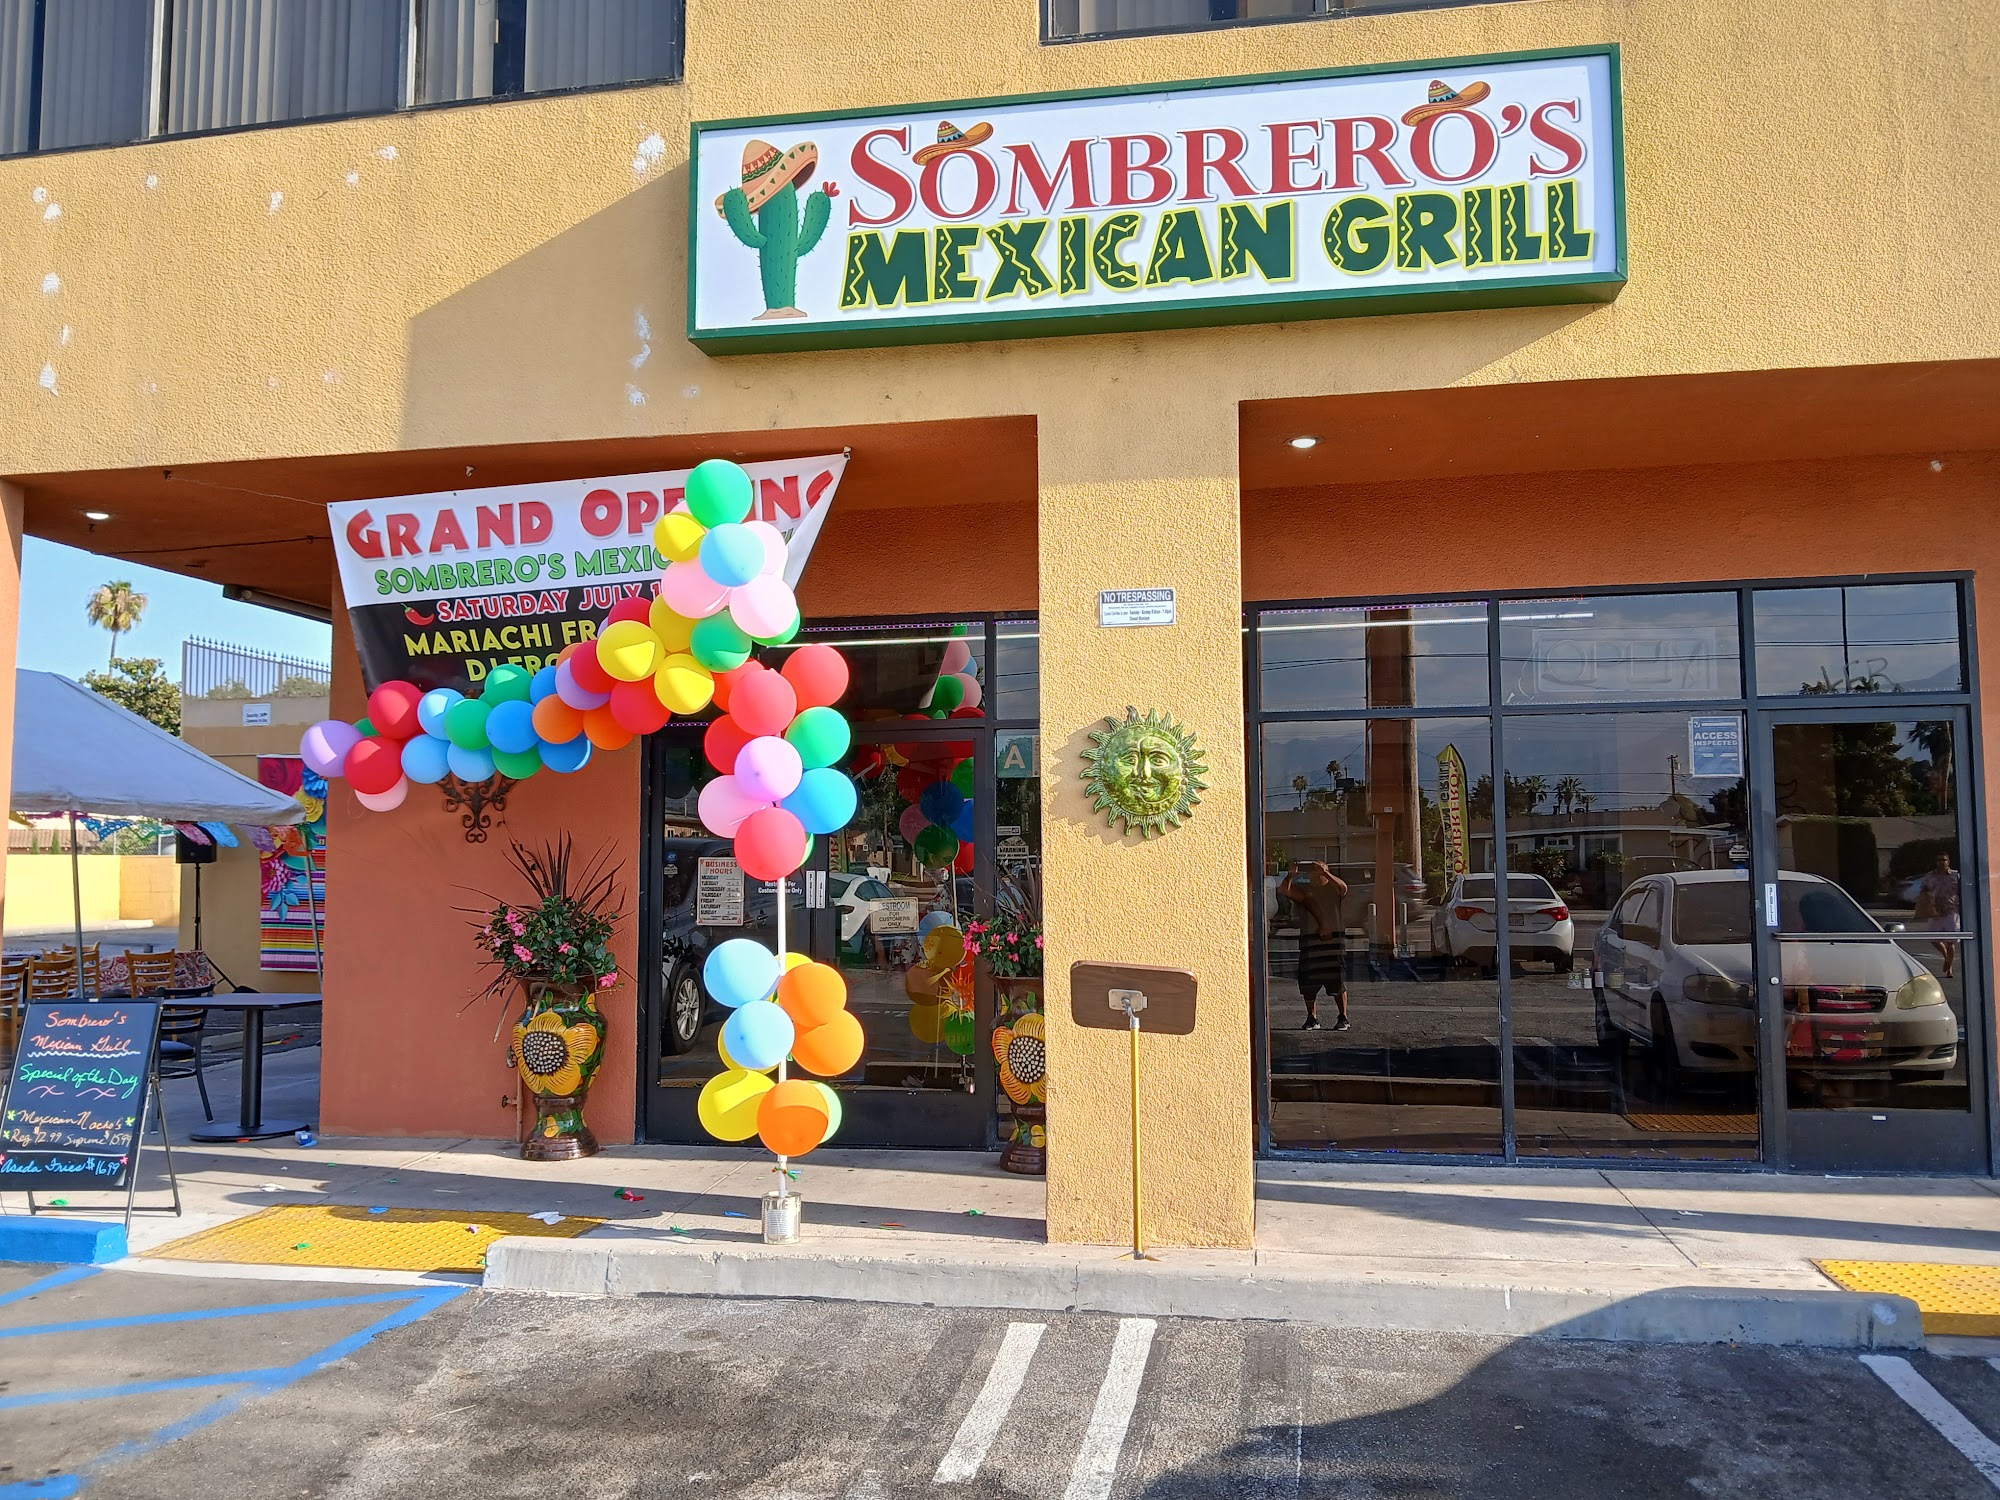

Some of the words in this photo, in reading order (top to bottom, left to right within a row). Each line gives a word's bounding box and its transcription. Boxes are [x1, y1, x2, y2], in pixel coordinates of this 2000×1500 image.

[850, 99, 1584, 228] SOMBRERO'S
[841, 200, 1294, 307] MEXICAN
[1325, 180, 1593, 275] GRILL
[346, 501, 553, 559] GRAND
[375, 553, 567, 595] SOMBRERO'S
[574, 545, 673, 578] MEXIC
[437, 590, 570, 623] SATURDAY
[1102, 592, 1116, 603] NO
[1116, 590, 1171, 602] TRESPASSING
[403, 621, 553, 657] MARIACHI
[1694, 731, 1738, 740] ACCESS
[1004, 745, 1026, 769] A
[30, 1034, 82, 1052] Mexican
[90, 1035, 131, 1052] Grill
[20, 1063, 73, 1083] Special
[108, 1068, 139, 1099] Day
[17, 1109, 78, 1126] Mexican
[10, 1128, 32, 1147] Reg
